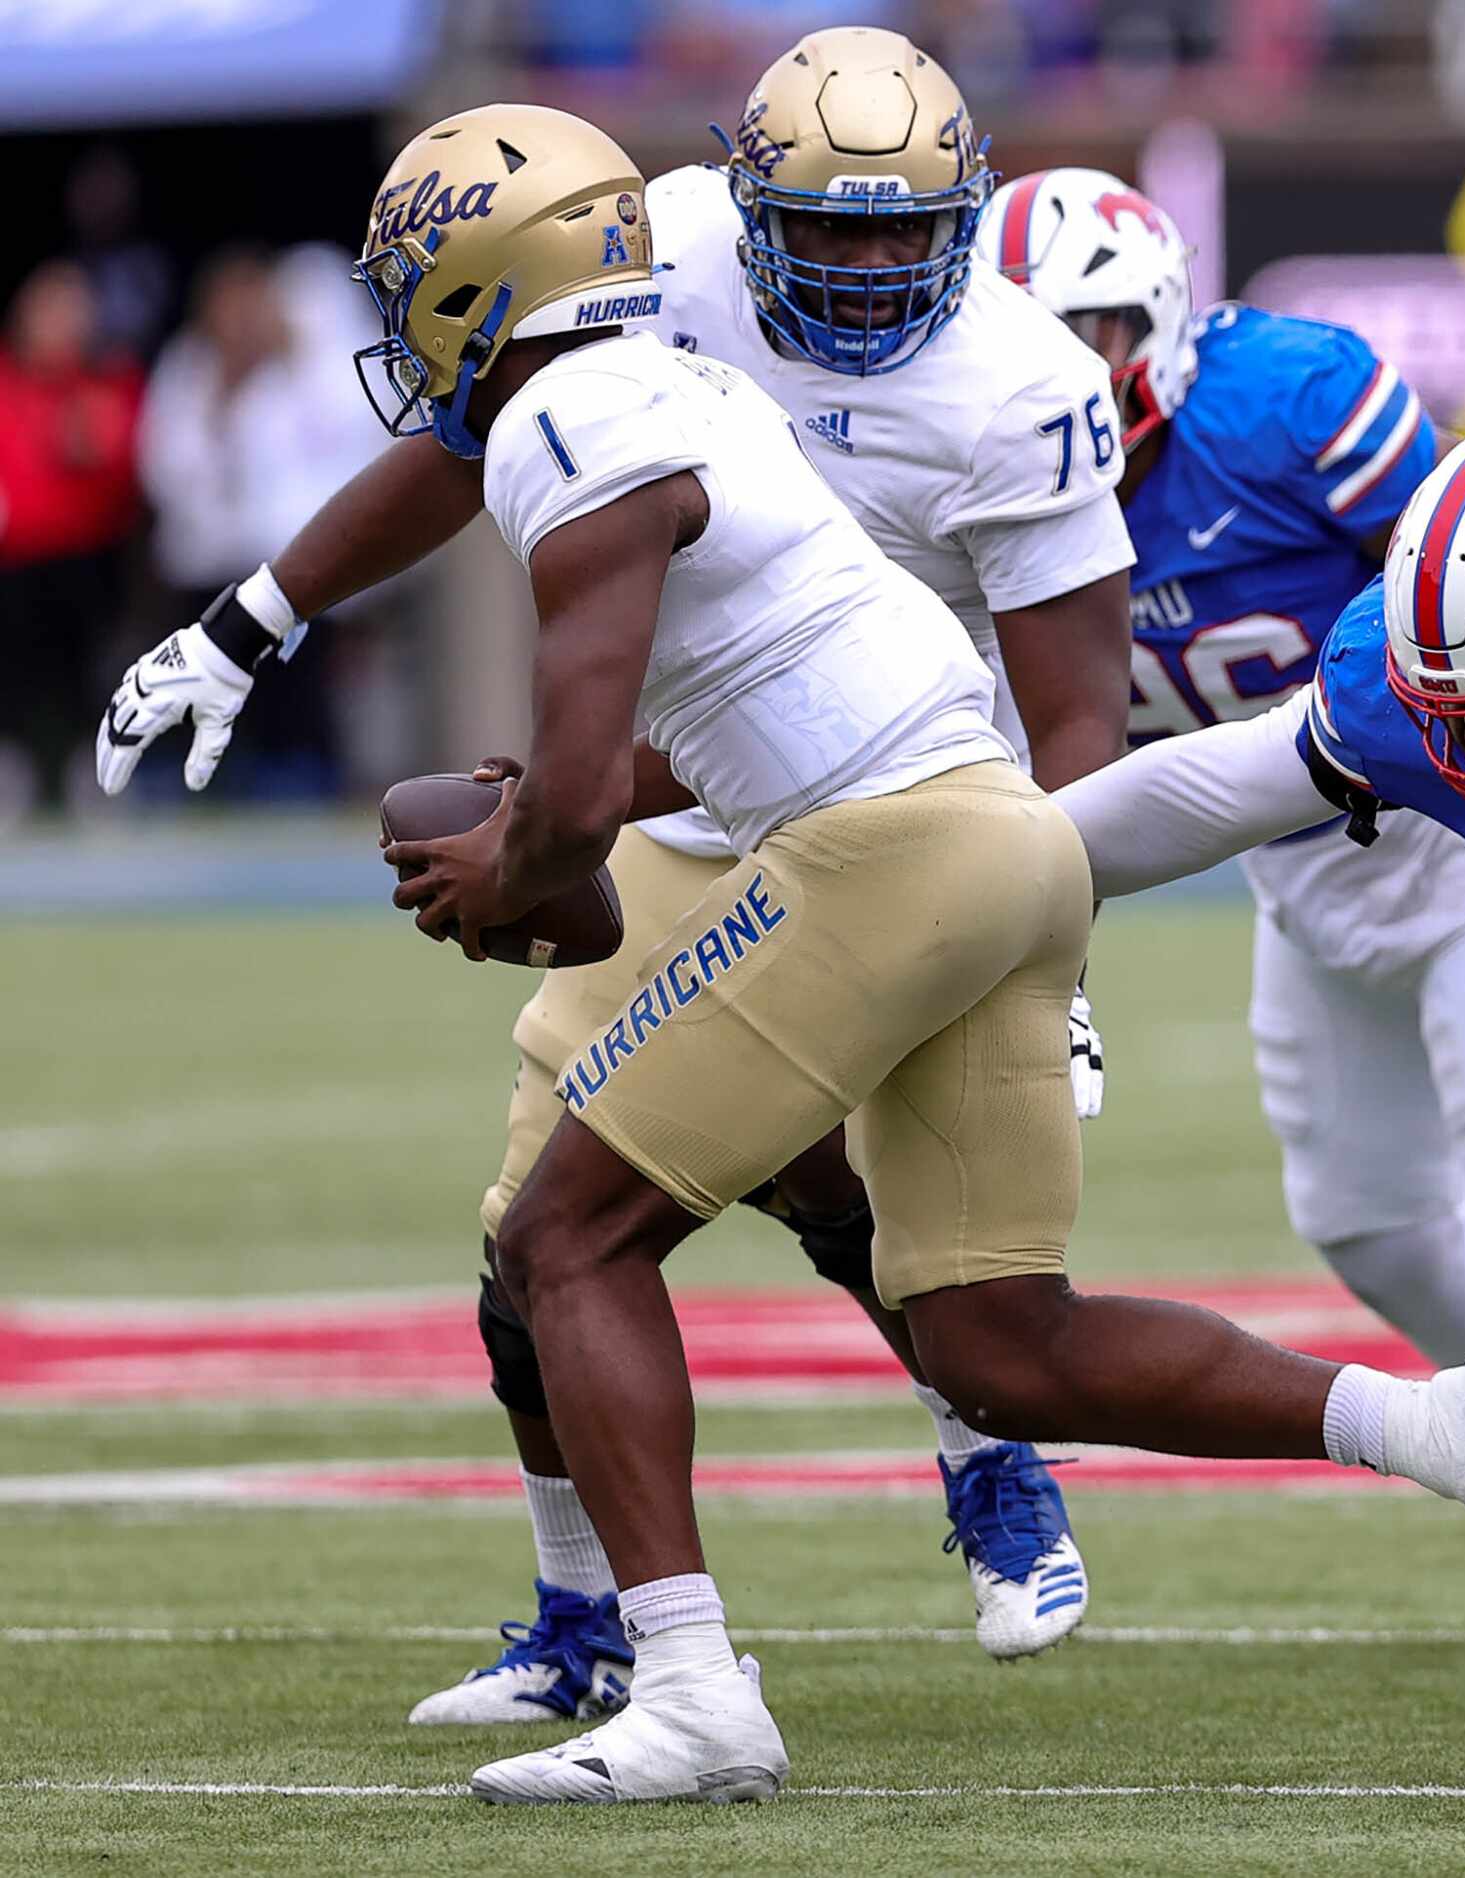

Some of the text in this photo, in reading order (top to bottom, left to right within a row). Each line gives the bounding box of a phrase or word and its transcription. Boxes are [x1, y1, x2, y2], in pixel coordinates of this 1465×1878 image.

[367, 170, 499, 257] Tulsa
[840, 180, 900, 197] TULSA
[834, 338, 881, 353] Riddll
[1036, 392, 1116, 497] 76
[1129, 579, 1194, 631] MU
[557, 871, 788, 1112] HURRICANE
